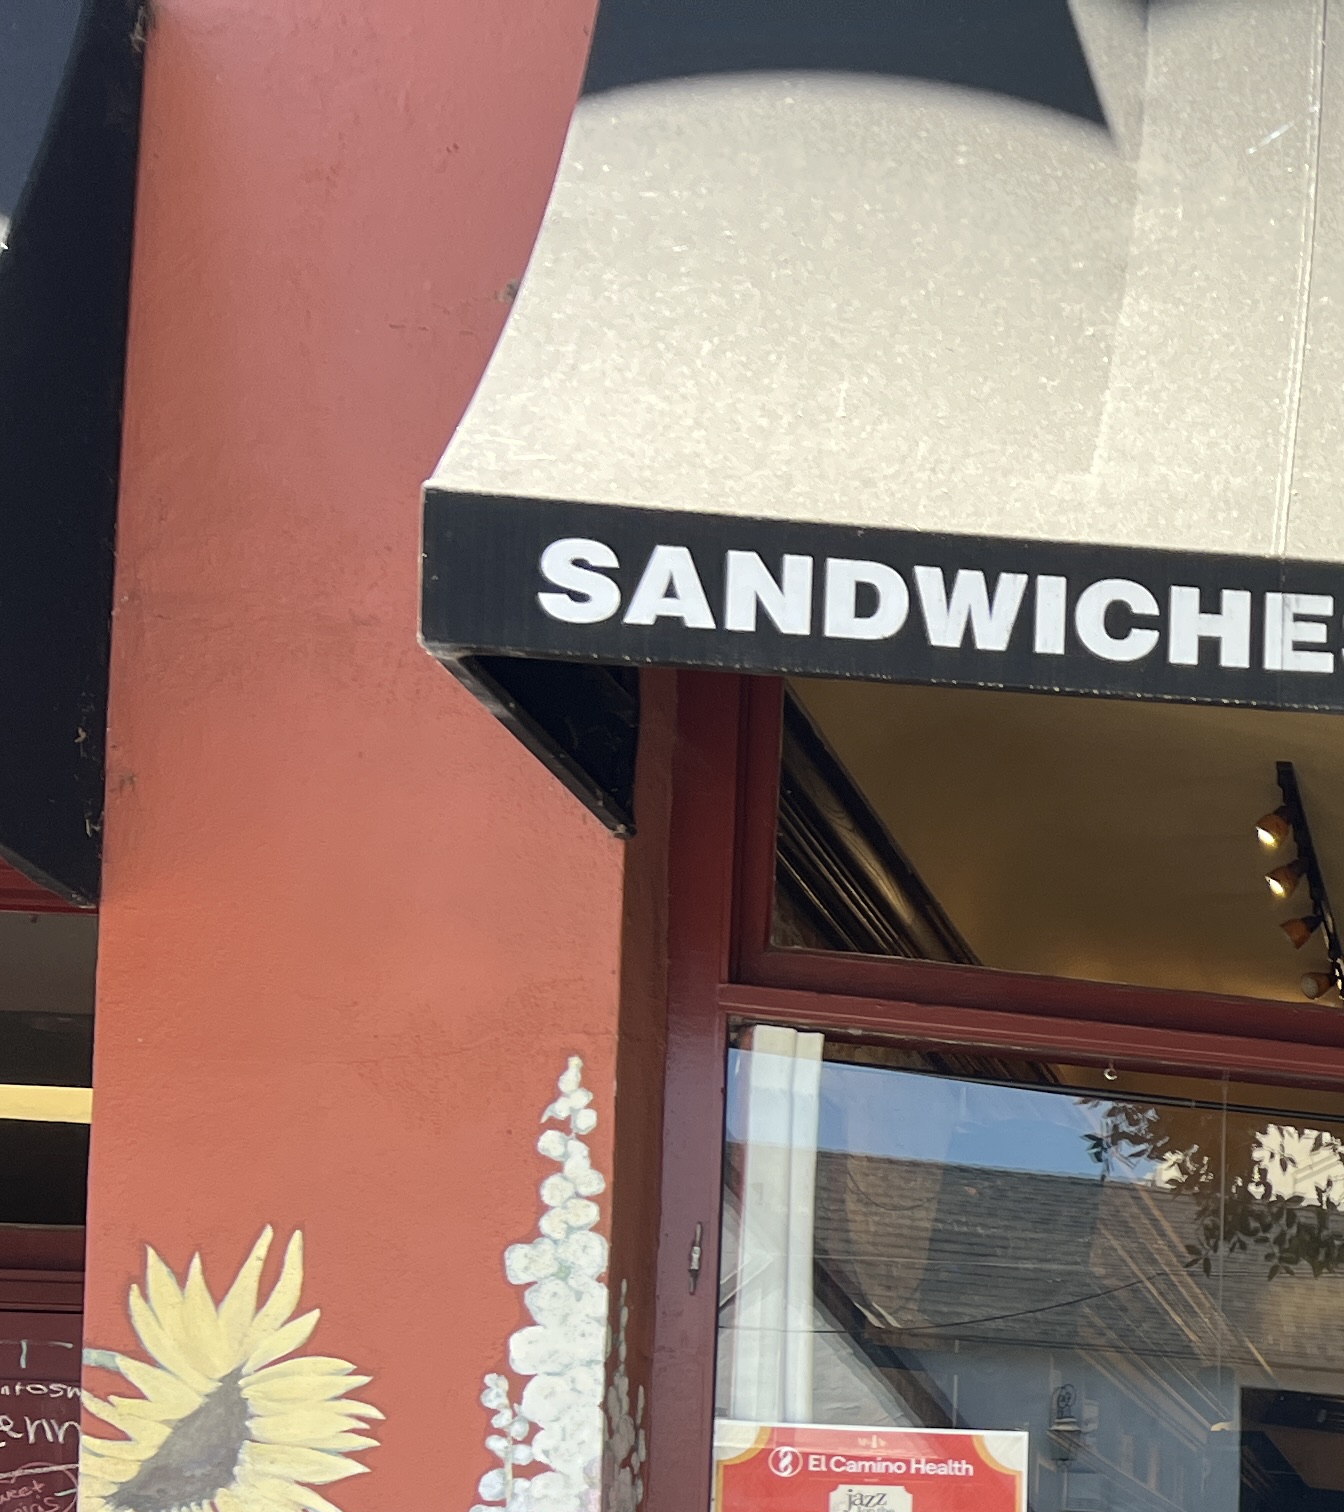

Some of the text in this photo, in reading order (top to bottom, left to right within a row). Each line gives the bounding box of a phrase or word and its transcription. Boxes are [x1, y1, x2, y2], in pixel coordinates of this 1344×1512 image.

[808, 1455, 974, 1476] El Camino Health
[845, 1488, 887, 1512] jazz
